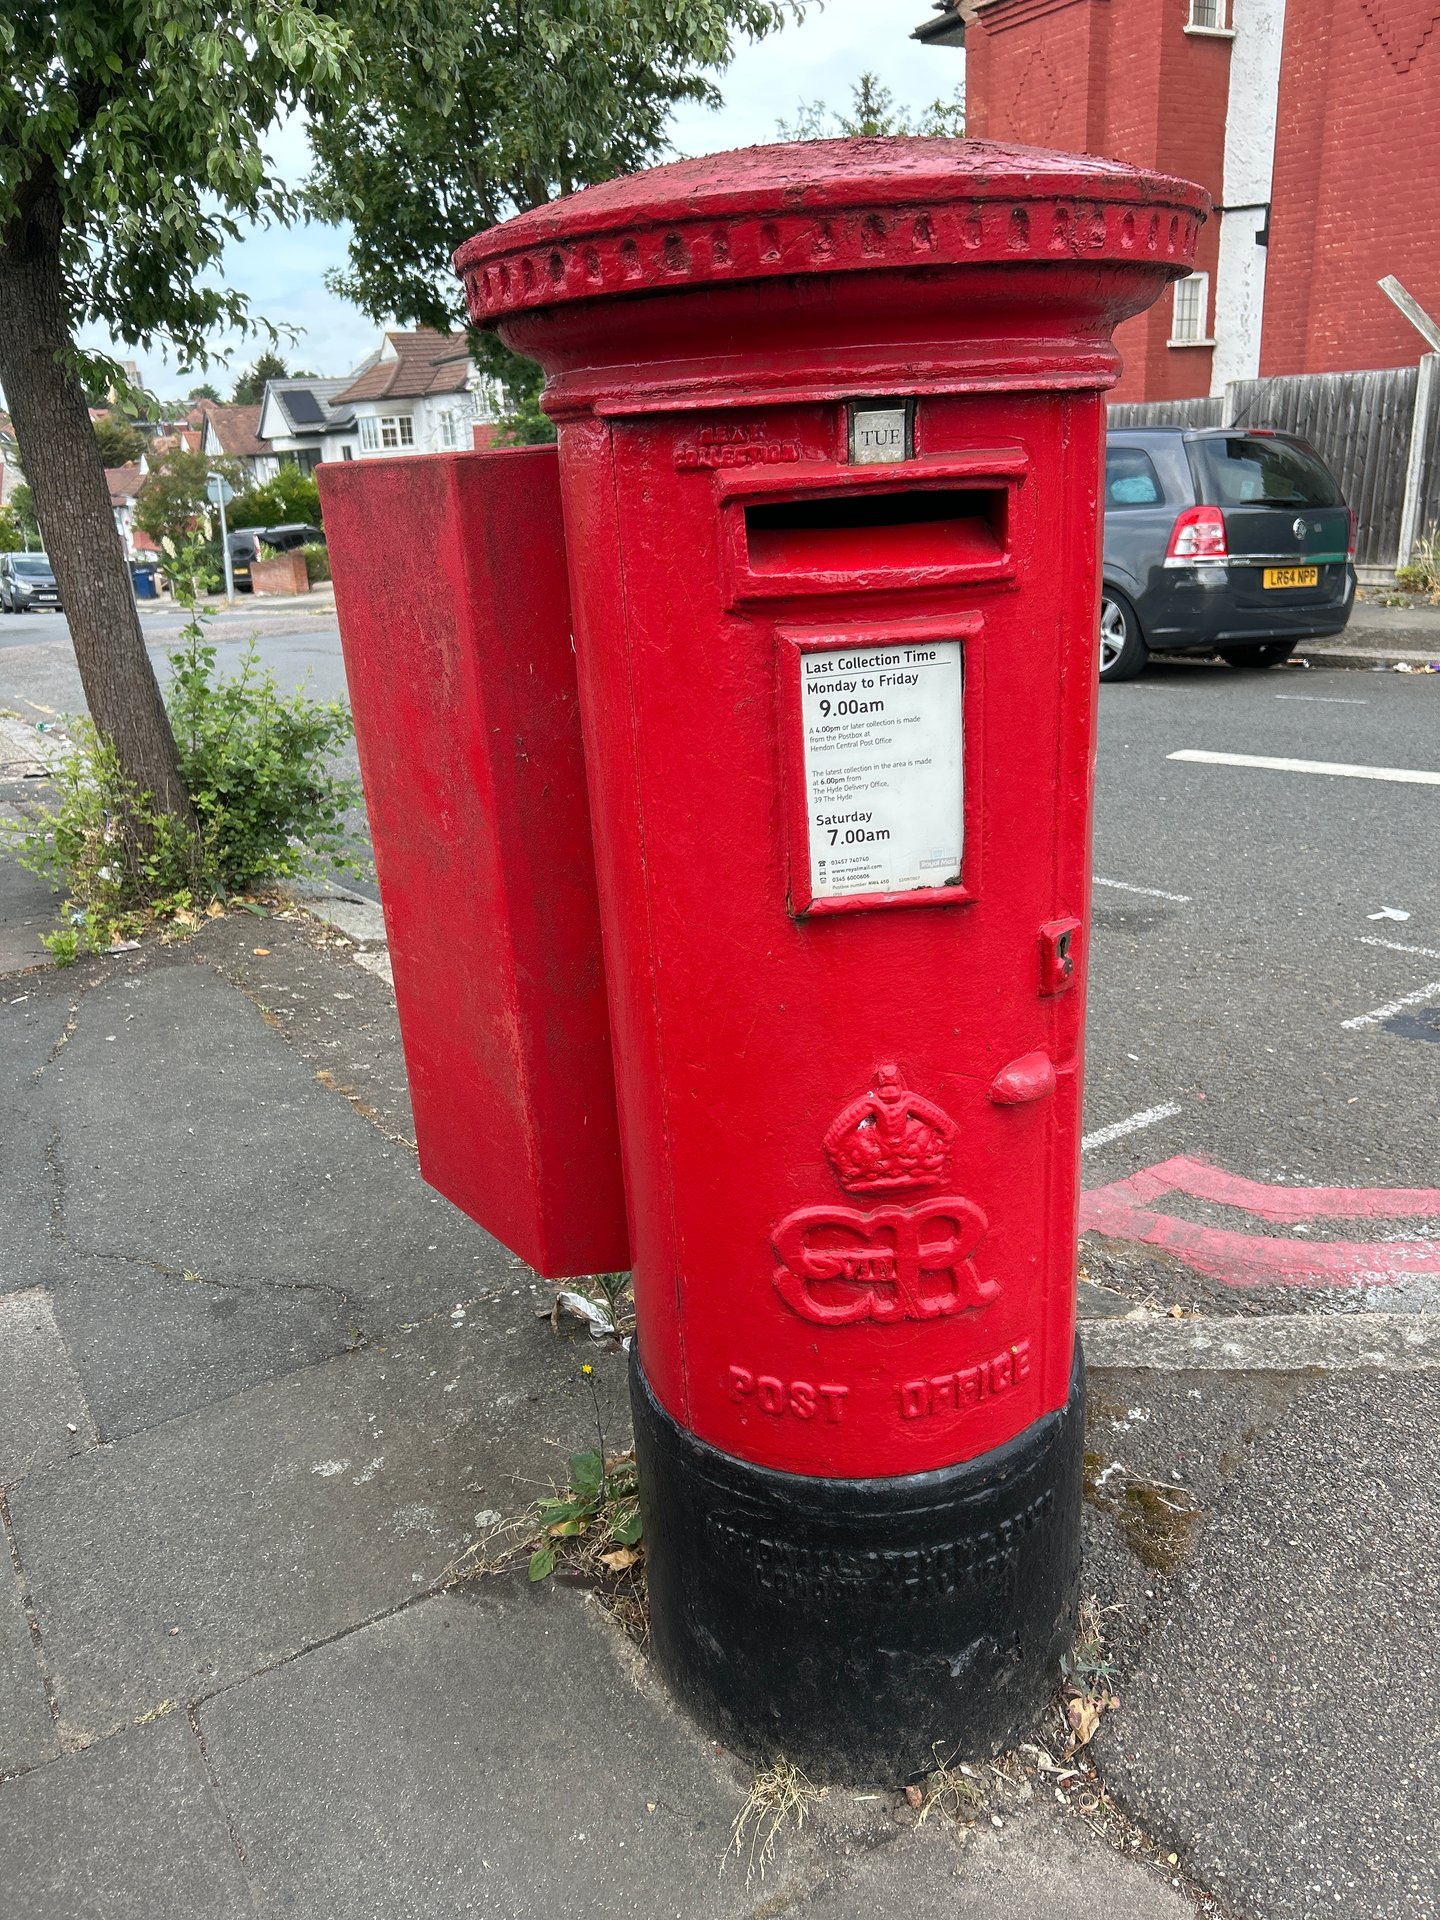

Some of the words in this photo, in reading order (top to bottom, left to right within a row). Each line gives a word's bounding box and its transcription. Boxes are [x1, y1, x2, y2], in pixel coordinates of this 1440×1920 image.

[861, 428, 900, 447] TUE
[1270, 570, 1295, 585] LR64
[1298, 569, 1316, 584] NPP
[806, 661, 834, 674] Last
[838, 653, 900, 670] Collection
[903, 650, 936, 662] Time
[807, 680, 857, 695] Monday
[861, 678, 874, 688] to
[879, 673, 919, 686] Friday
[819, 699, 884, 718] 9.00am
[815, 725, 840, 734] 4.00pm
[866, 718, 895, 728] collection
[903, 715, 921, 724] made
[809, 736, 825, 744] from
[826, 734, 836, 742] the
[838, 731, 862, 740] Postbox
[810, 743, 835, 752] Hendon
[836, 740, 858, 750] Central
[859, 739, 874, 747] Post
[874, 737, 893, 745] Office
[825, 768, 843, 776] latest
[843, 764, 872, 774] collection
[880, 762, 891, 770] the
[914, 757, 932, 765] made
[813, 787, 825, 795] The
[826, 785, 842, 794] Hyde
[843, 782, 868, 792] Delivery
[820, 776, 845, 786] 6.00pm
[846, 774, 862, 782] from
[814, 796, 822, 804] 39
[824, 795, 835, 803] The
[837, 793, 852, 802] Hyde
[816, 810, 873, 826] Saturday
[827, 828, 890, 846] 7.00am
[831, 864, 882, 874] www.royalmail.com
[729, 1365, 849, 1422] POST
[900, 1337, 1031, 1419] OFFICE
